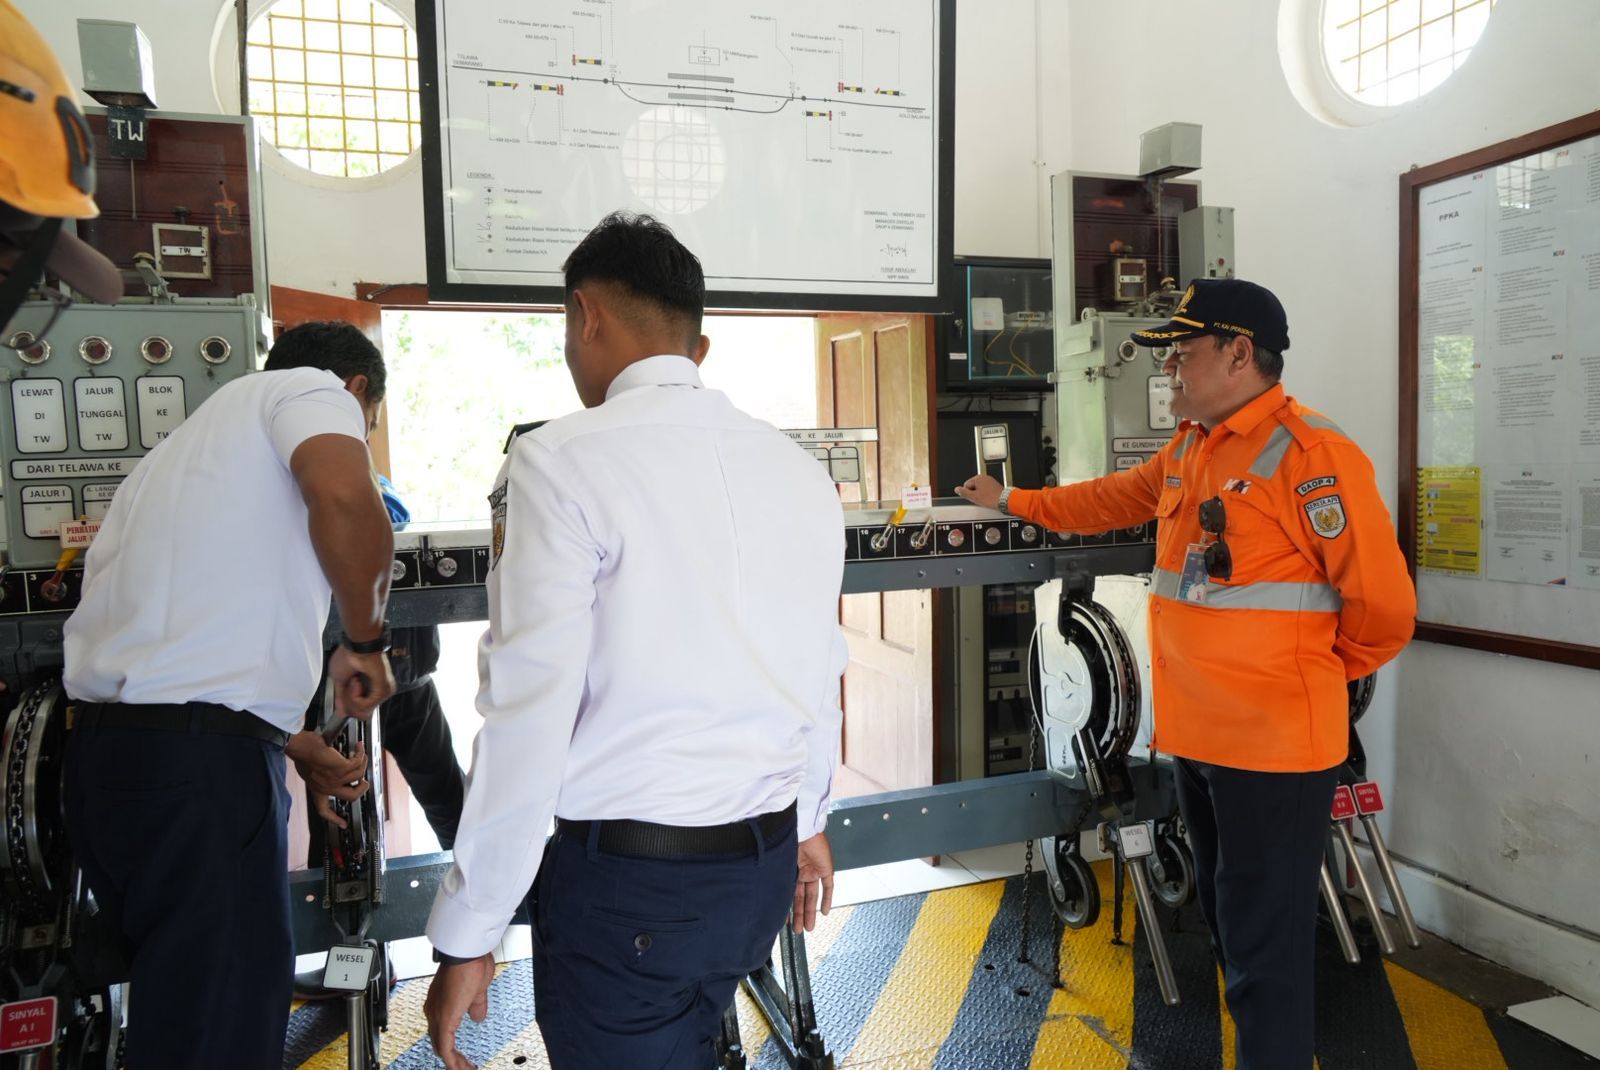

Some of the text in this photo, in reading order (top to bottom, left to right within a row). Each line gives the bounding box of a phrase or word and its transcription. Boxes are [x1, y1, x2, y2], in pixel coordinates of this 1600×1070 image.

[111, 119, 144, 141] TW
[1439, 210, 1460, 222] PPKA
[20, 388, 54, 397] LEWAT
[85, 386, 114, 395] JALUR
[149, 386, 173, 394] BLOK
[34, 412, 45, 420] DI
[79, 410, 124, 418] TUNGGAL
[156, 408, 168, 417] KE
[33, 435, 51, 443] TW
[96, 433, 112, 442] TW
[156, 431, 172, 440] TW
[1131, 441, 1156, 449] GUNDIH
[26, 462, 122, 474] DARI TELAWA KE
[1301, 479, 1324, 492] DAOP
[29, 489, 66, 498] JALUR I
[336, 953, 365, 963] WESEL
[343, 973, 348, 981] 1
[8, 1007, 46, 1021] SINYAL
[19, 1024, 28, 1034] A
